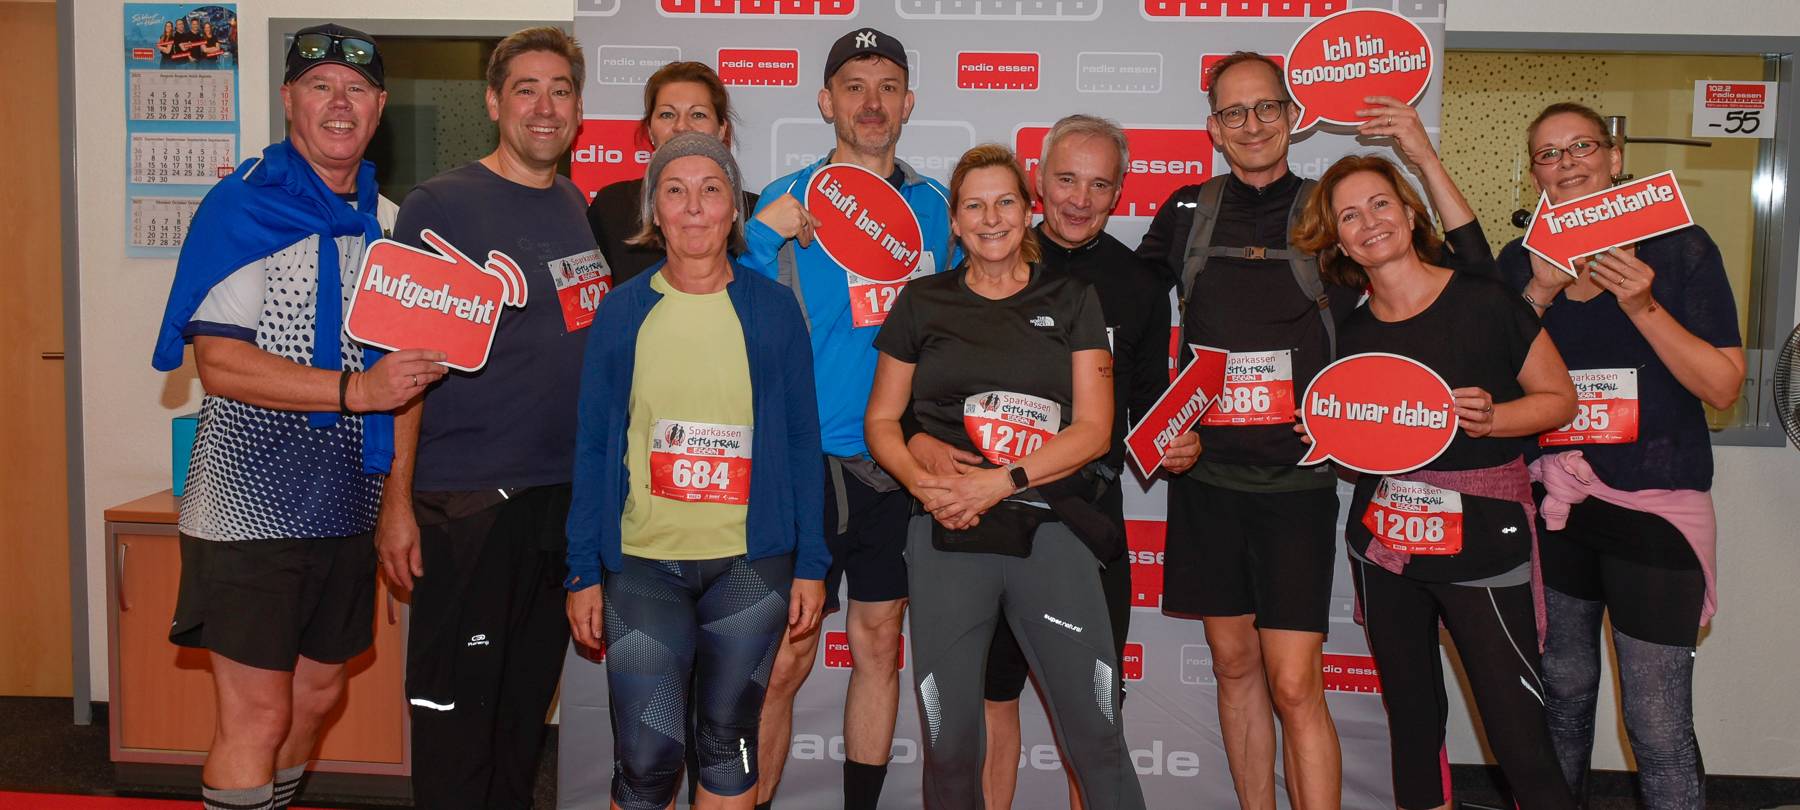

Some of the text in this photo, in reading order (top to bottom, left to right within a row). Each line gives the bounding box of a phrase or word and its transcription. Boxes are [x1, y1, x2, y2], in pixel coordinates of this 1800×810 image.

[856, 32, 878, 48] NY
[1323, 35, 1383, 61] Ich bin
[604, 58, 635, 66] radio
[722, 60, 754, 68] radio
[962, 64, 994, 72] radio
[1082, 64, 1115, 72] radio
[1369, 47, 1426, 73] schön!
[816, 173, 918, 267] Läuft bei mir!
[1542, 184, 1674, 235] Tratschtante
[364, 264, 494, 324] Aufgedreht
[1228, 355, 1276, 364] parkassen
[1003, 395, 1051, 412] Sparkassen
[1222, 386, 1270, 413] 686
[1312, 392, 1449, 429] Ich war dabei
[1154, 388, 1208, 456] Kumpel
[1558, 404, 1610, 432] 85
[688, 426, 741, 437] Sparkassen
[979, 422, 1042, 456] 1210
[672, 459, 730, 490] 684
[1392, 483, 1442, 494] Sparkassen
[1374, 510, 1444, 542] 1208
[1323, 665, 1342, 674] dio
